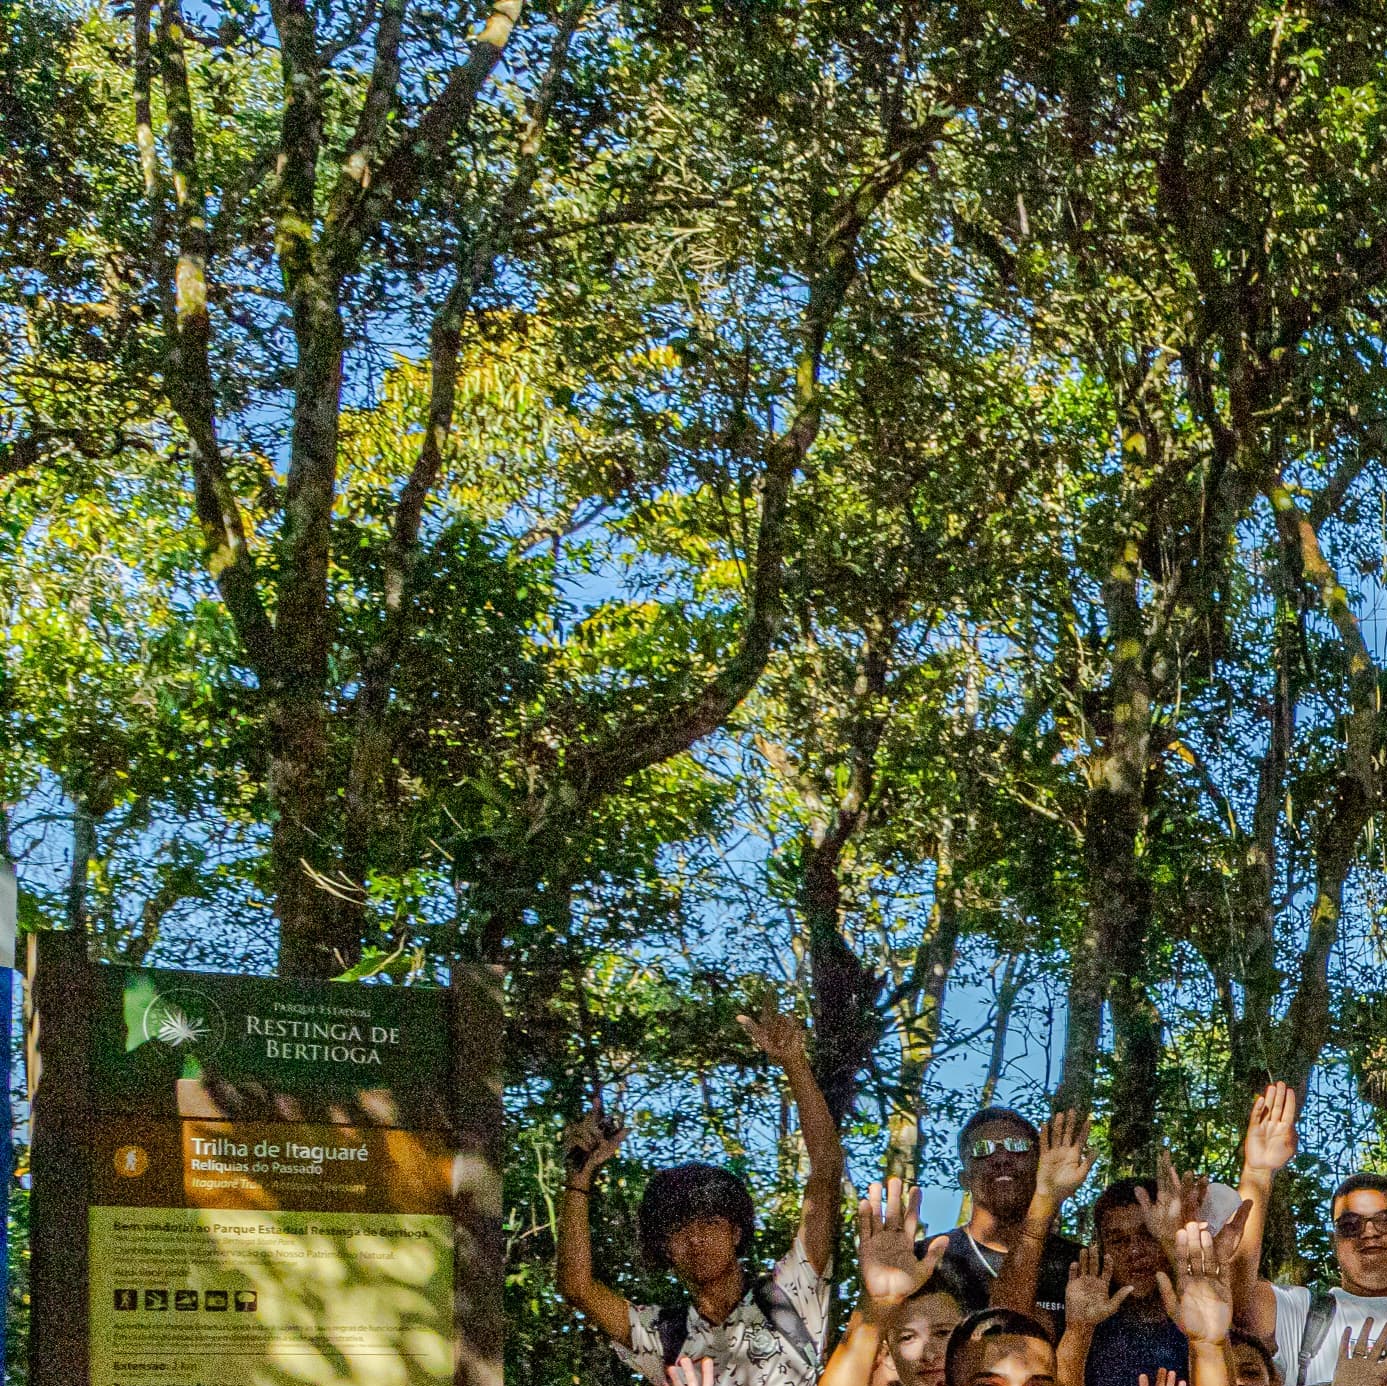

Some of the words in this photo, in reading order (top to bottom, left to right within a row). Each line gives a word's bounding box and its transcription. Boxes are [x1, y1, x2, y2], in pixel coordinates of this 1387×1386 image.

[246, 1015, 363, 1041] RESTINGA
[371, 1026, 400, 1044] DE
[266, 1039, 383, 1065] BERTIOGA
[191, 1137, 249, 1157] Trilha
[253, 1139, 280, 1158] de
[285, 1141, 369, 1163] Itaguaré
[252, 1161, 269, 1173] do
[272, 1162, 323, 1175] Passado
[213, 1223, 256, 1236] Parque
[258, 1224, 308, 1235] Estadual
